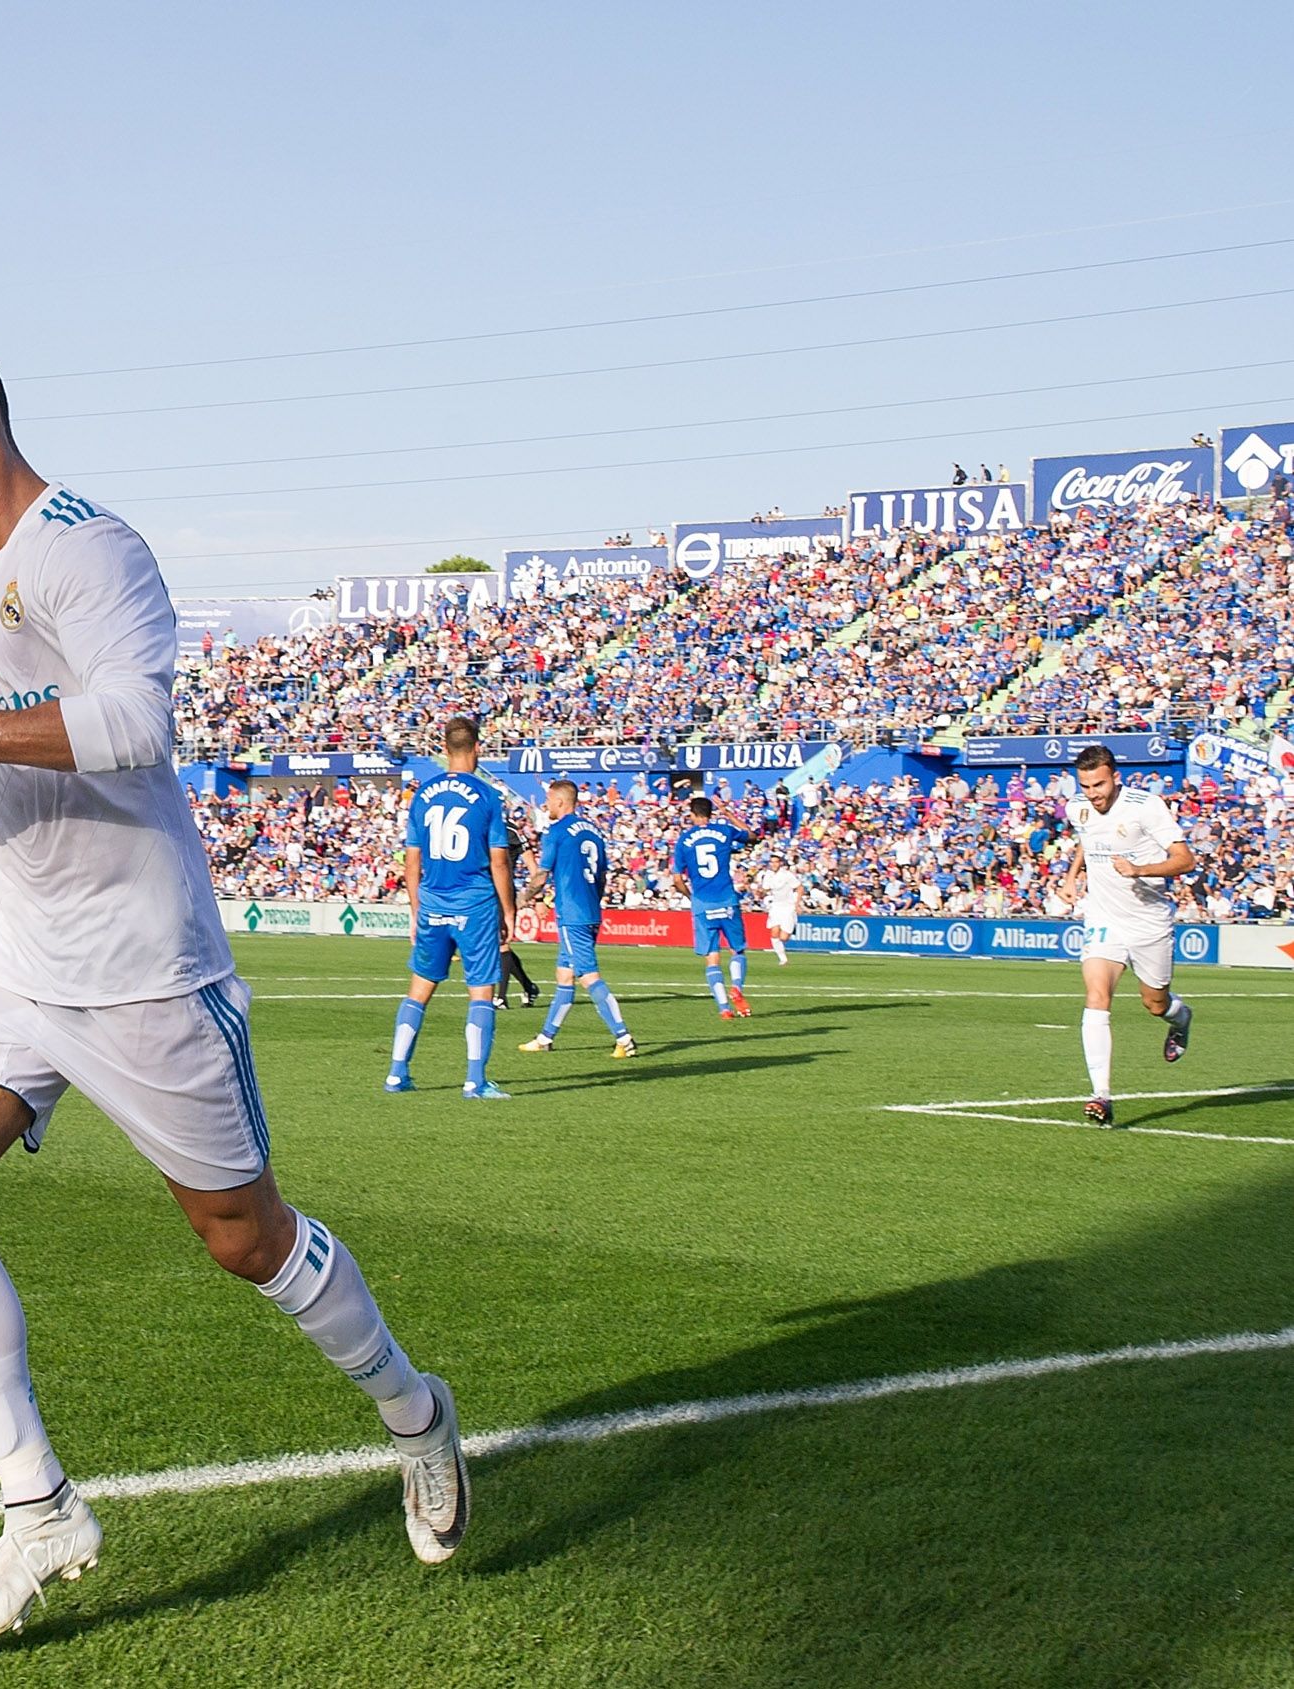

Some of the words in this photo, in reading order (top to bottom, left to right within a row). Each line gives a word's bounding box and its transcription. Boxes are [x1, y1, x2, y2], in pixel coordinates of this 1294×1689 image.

[1052, 461, 1192, 510] Coca-Cola
[851, 488, 1023, 537] LUJISA
[562, 554, 651, 576] Antonio
[338, 578, 493, 618] LUJISA
[718, 743, 804, 768] LUJISA
[424, 804, 470, 862] 16
[580, 839, 599, 884] 3
[695, 843, 719, 879] 5
[602, 918, 669, 937] Santander
[792, 922, 841, 942] llianz
[881, 924, 944, 946] Allianz
[992, 926, 1059, 950] Allianz
[1083, 926, 1108, 945] 21
